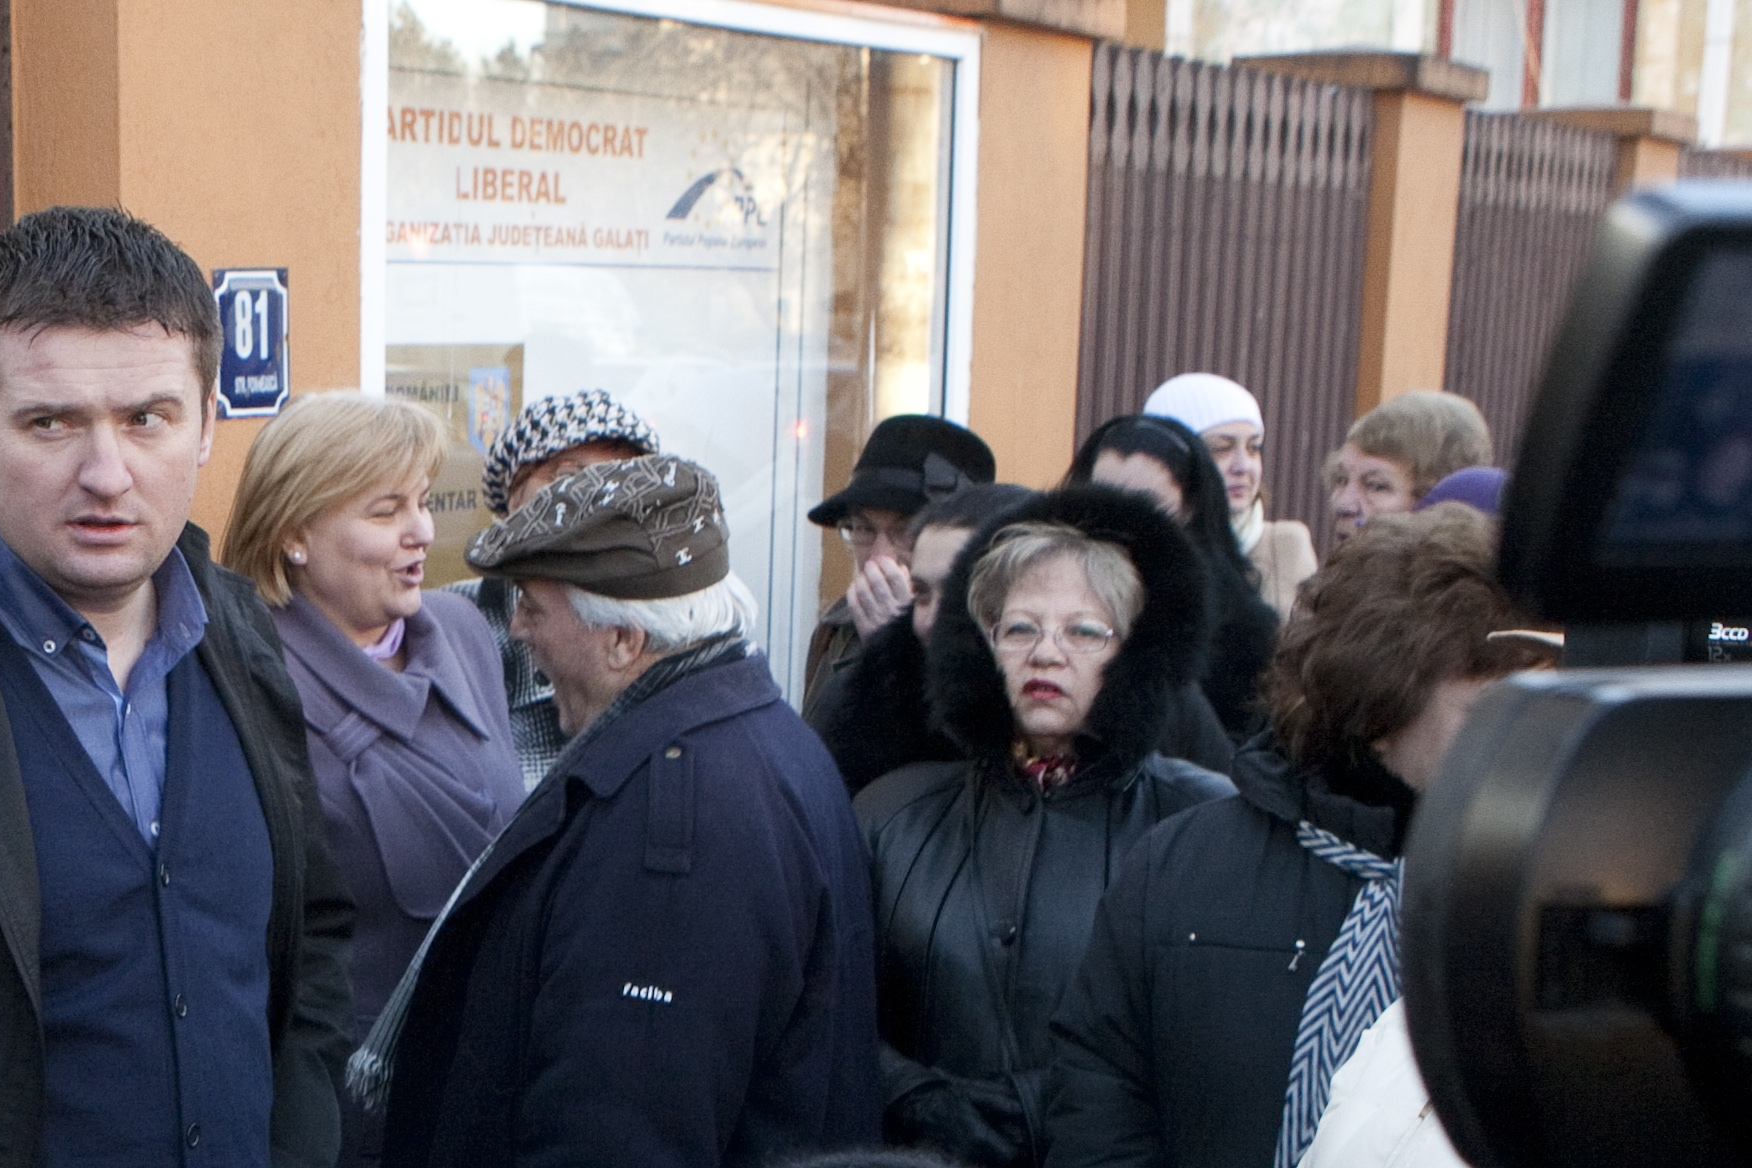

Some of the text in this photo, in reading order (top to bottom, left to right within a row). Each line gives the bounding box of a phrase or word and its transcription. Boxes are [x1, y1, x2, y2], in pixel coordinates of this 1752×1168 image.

[510, 115, 648, 158] DEMOCRAT
[456, 166, 566, 205] LIBERAL
[235, 289, 268, 360] 81
[1708, 622, 1749, 641] 3CCD
